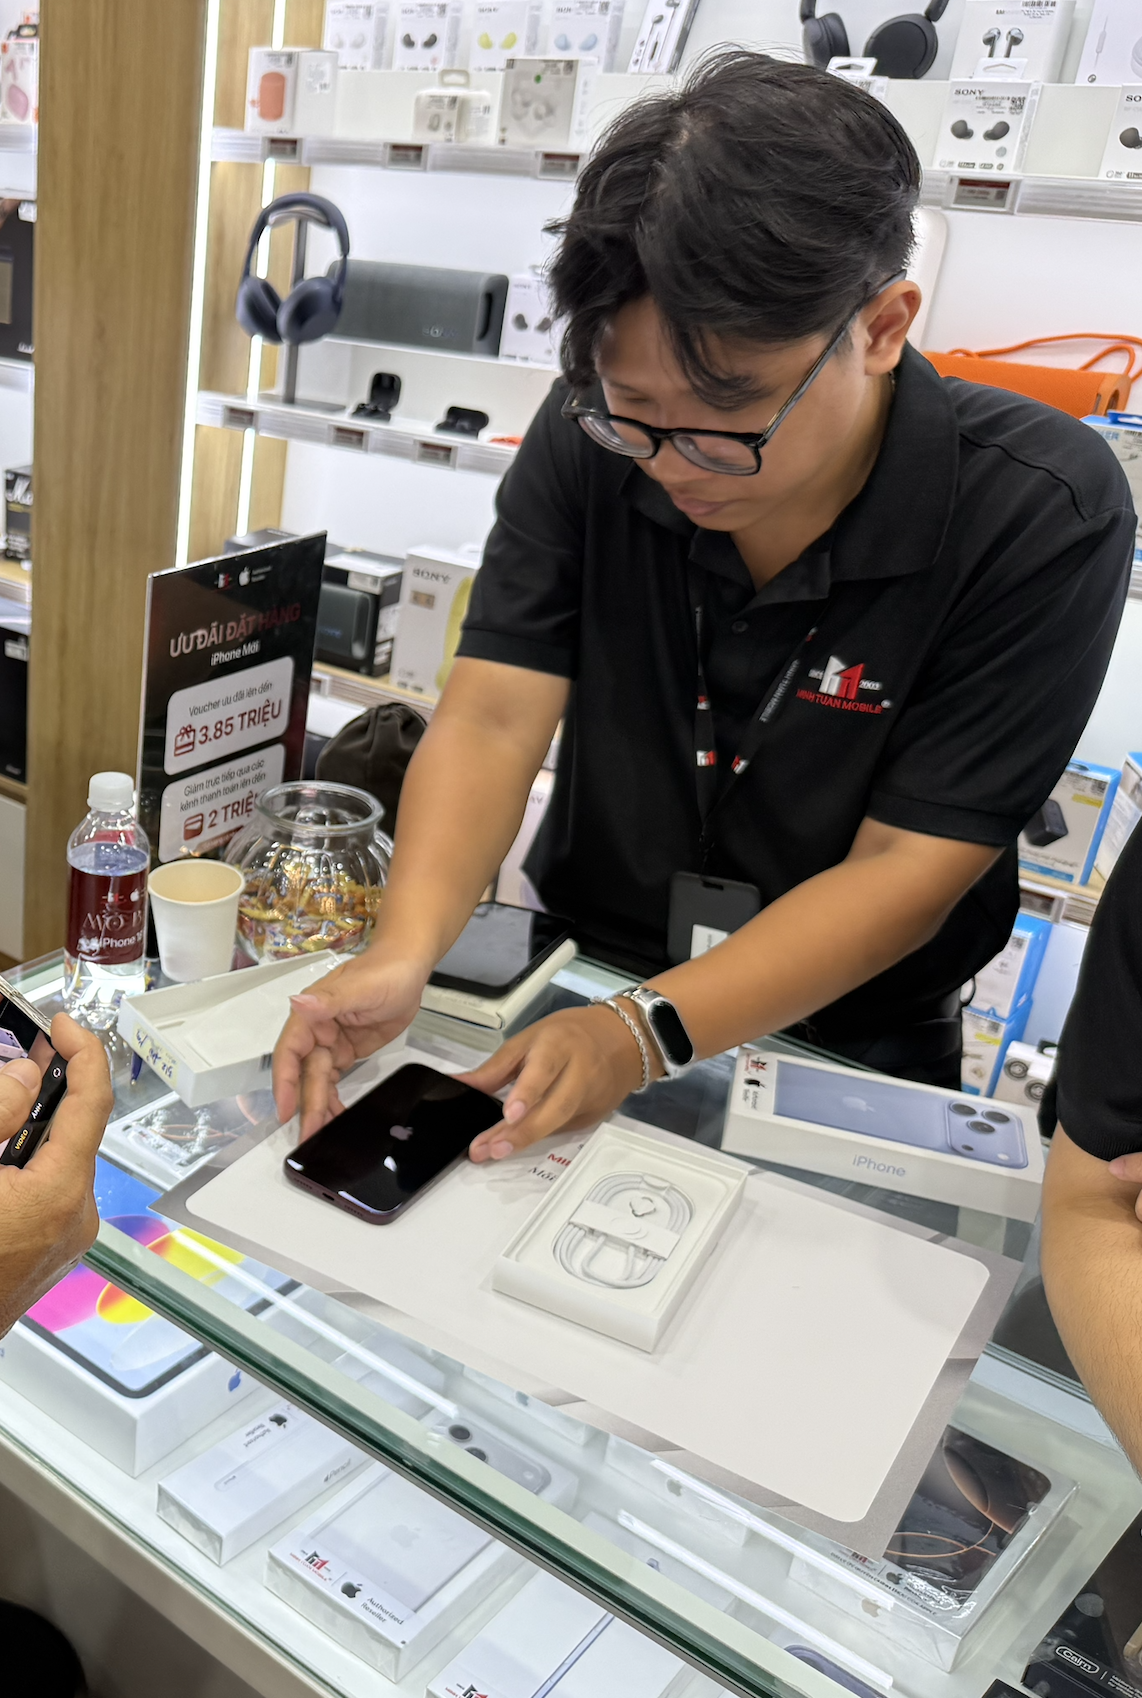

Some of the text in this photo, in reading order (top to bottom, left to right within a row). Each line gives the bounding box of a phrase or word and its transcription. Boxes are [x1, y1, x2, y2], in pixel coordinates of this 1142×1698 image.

[954, 88, 985, 96] SONY
[412, 568, 451, 584] SONY
[210, 647, 242, 667] iPhone
[188, 698, 220, 717] Voucher
[842, 700, 884, 715] MOBILE
[198, 698, 283, 745] 3.85 TRIỆU
[208, 789, 258, 829] 2 TRIỆ
[14, 1129, 29, 1150] VIDEO
[852, 1154, 906, 1178] iPhone
[360, 1602, 387, 1623] Reseller
[367, 1597, 405, 1626] Authorized
